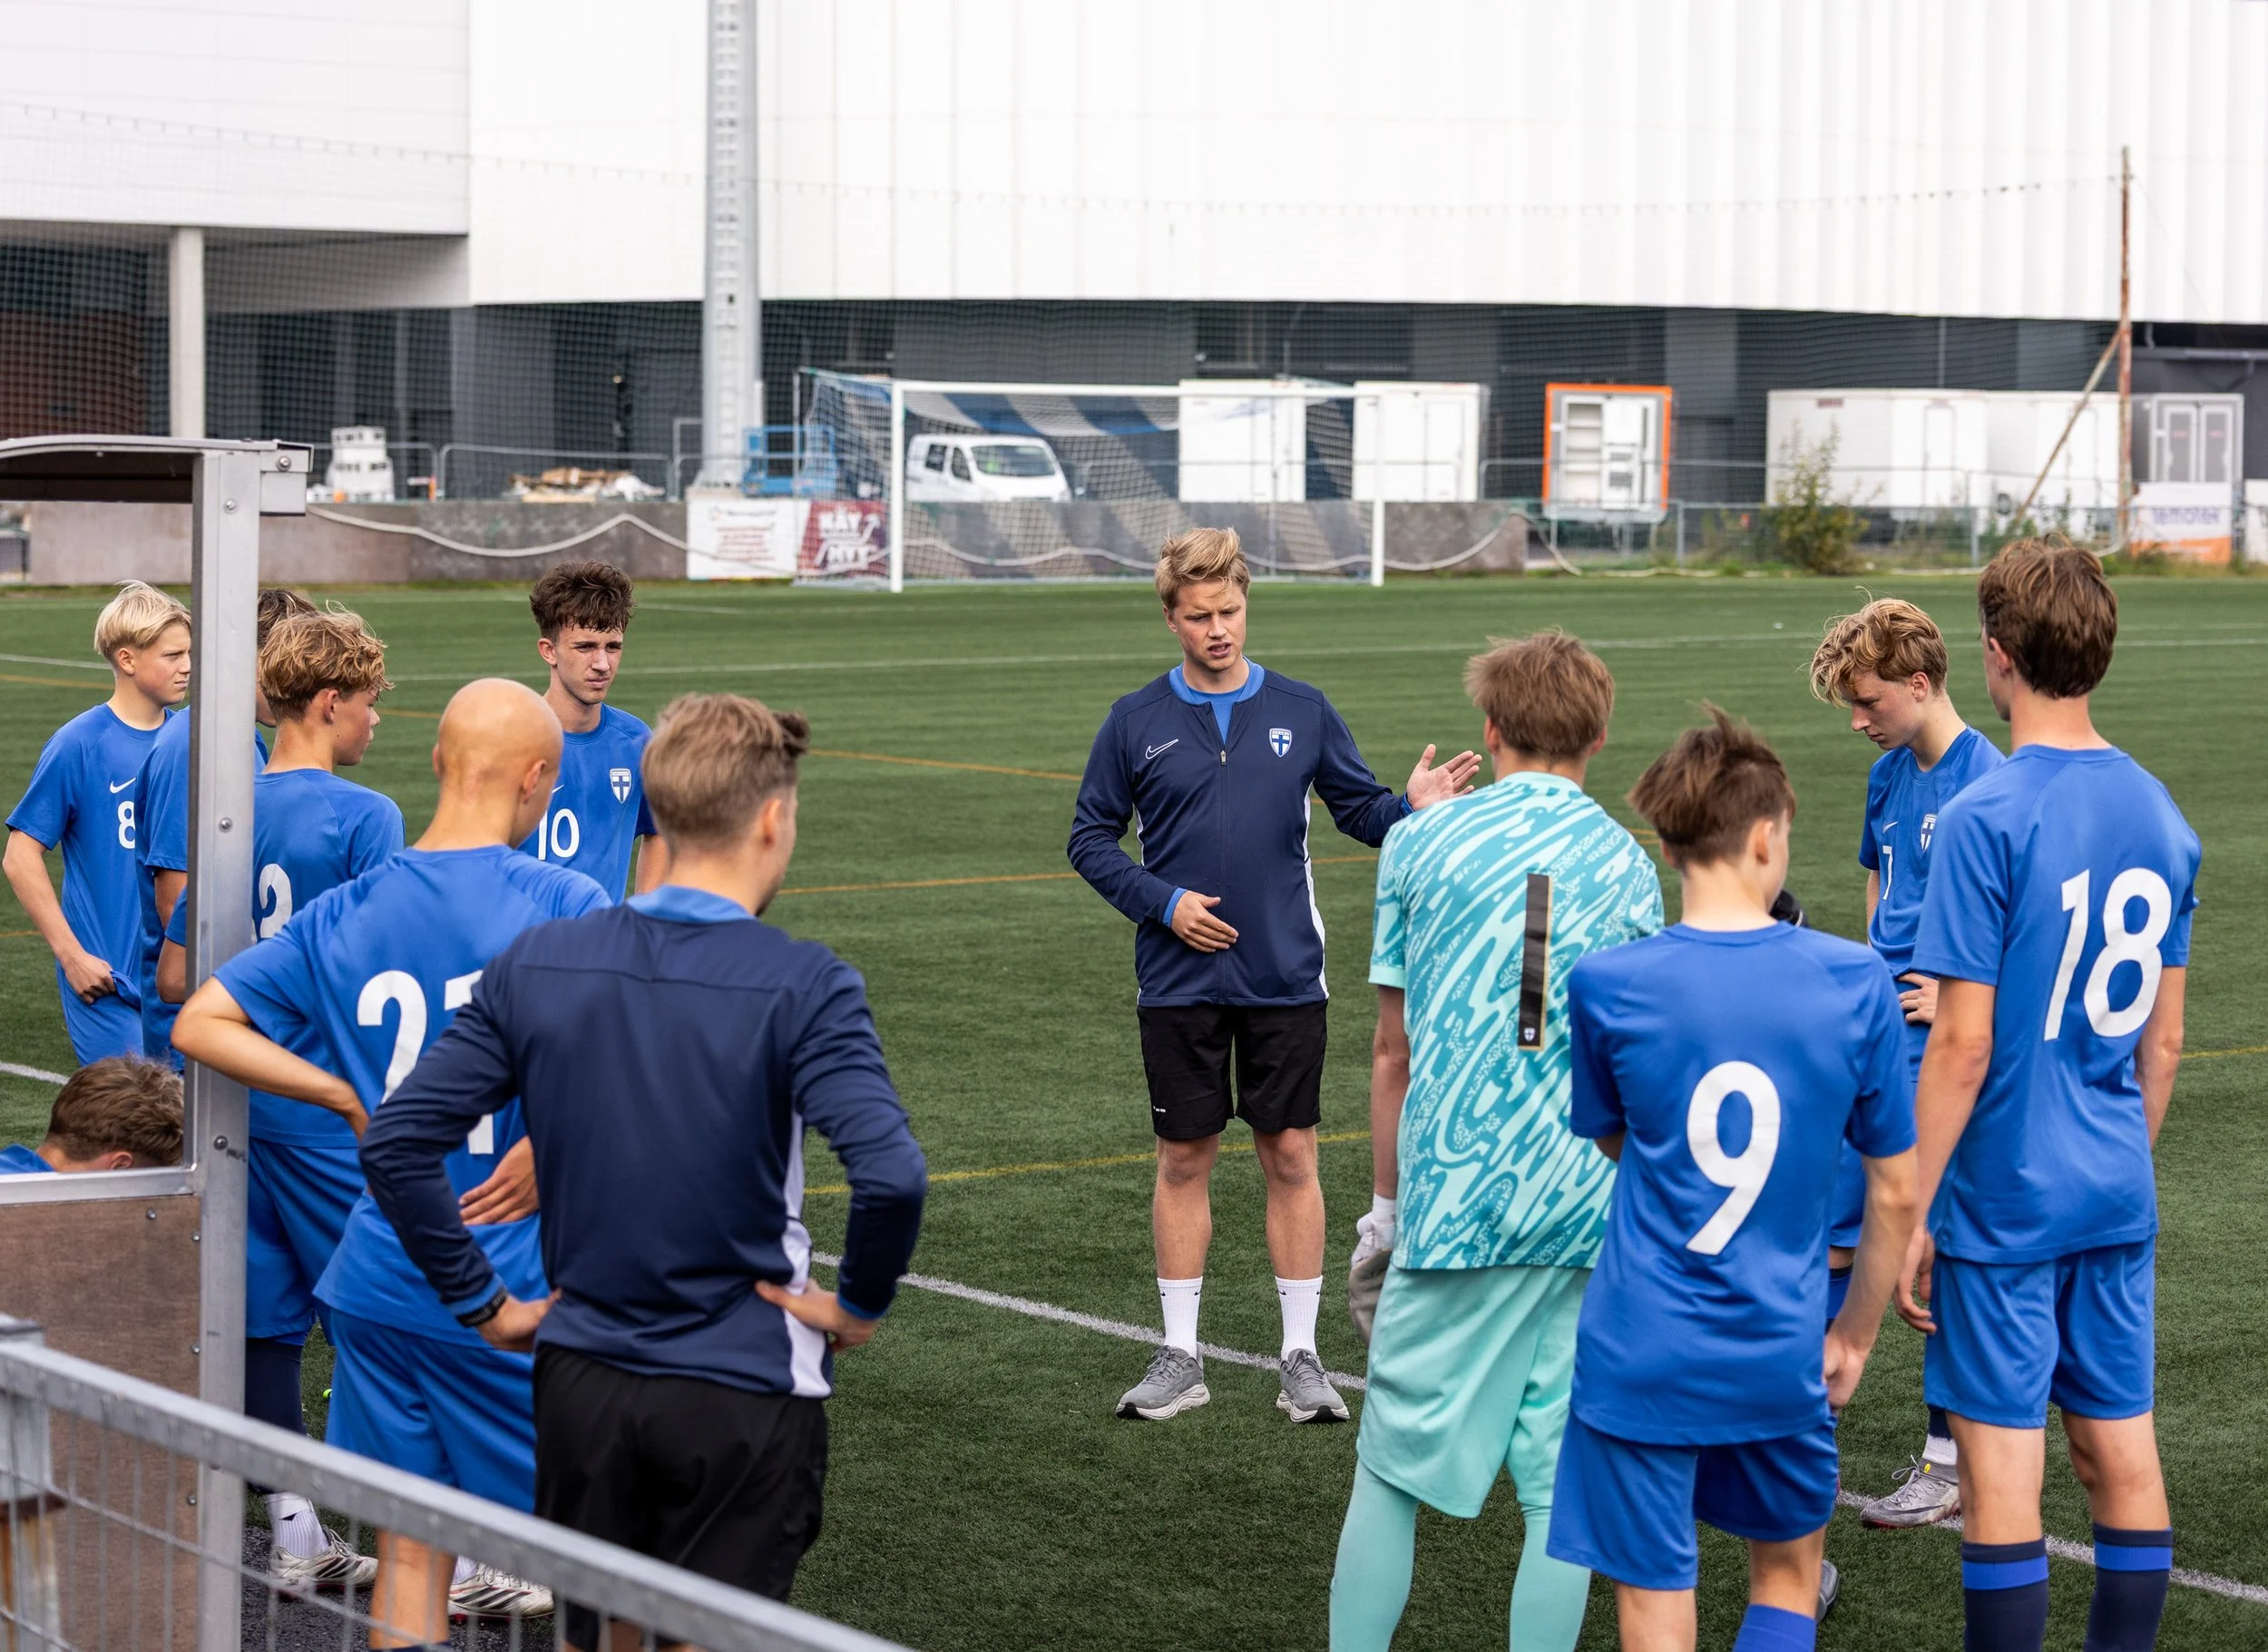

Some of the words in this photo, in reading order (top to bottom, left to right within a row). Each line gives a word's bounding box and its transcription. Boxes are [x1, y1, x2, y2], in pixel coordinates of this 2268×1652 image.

[117, 801, 135, 849] 8
[538, 808, 580, 861] 10
[1882, 845, 1893, 900] 7
[2044, 867, 2172, 1041] 18
[1686, 1061, 1782, 1255] 9
